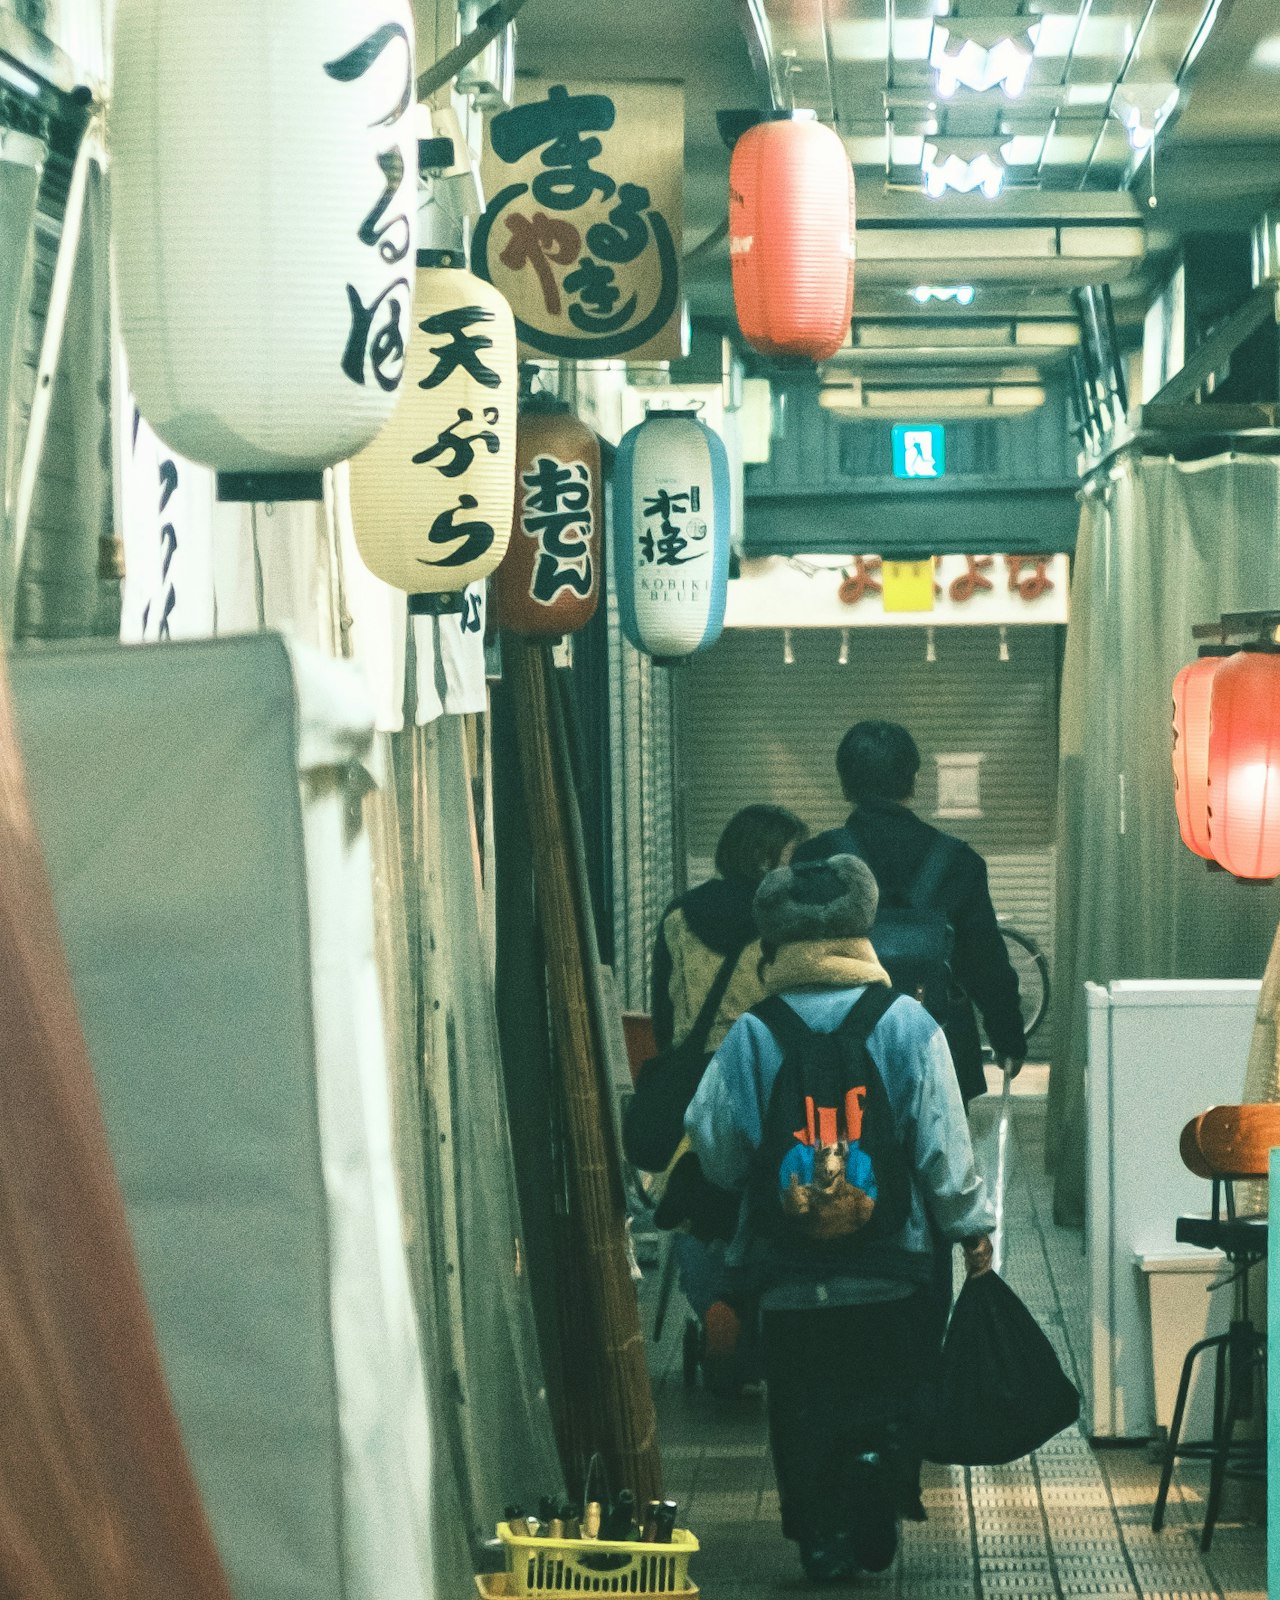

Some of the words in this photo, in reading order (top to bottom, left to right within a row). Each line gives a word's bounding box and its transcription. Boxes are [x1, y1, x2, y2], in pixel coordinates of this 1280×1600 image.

[412, 304, 501, 568] 天ぷら
[521, 455, 594, 604] おでん
[640, 578, 709, 590] KOBIKI
[650, 590, 700, 602] BLUE
